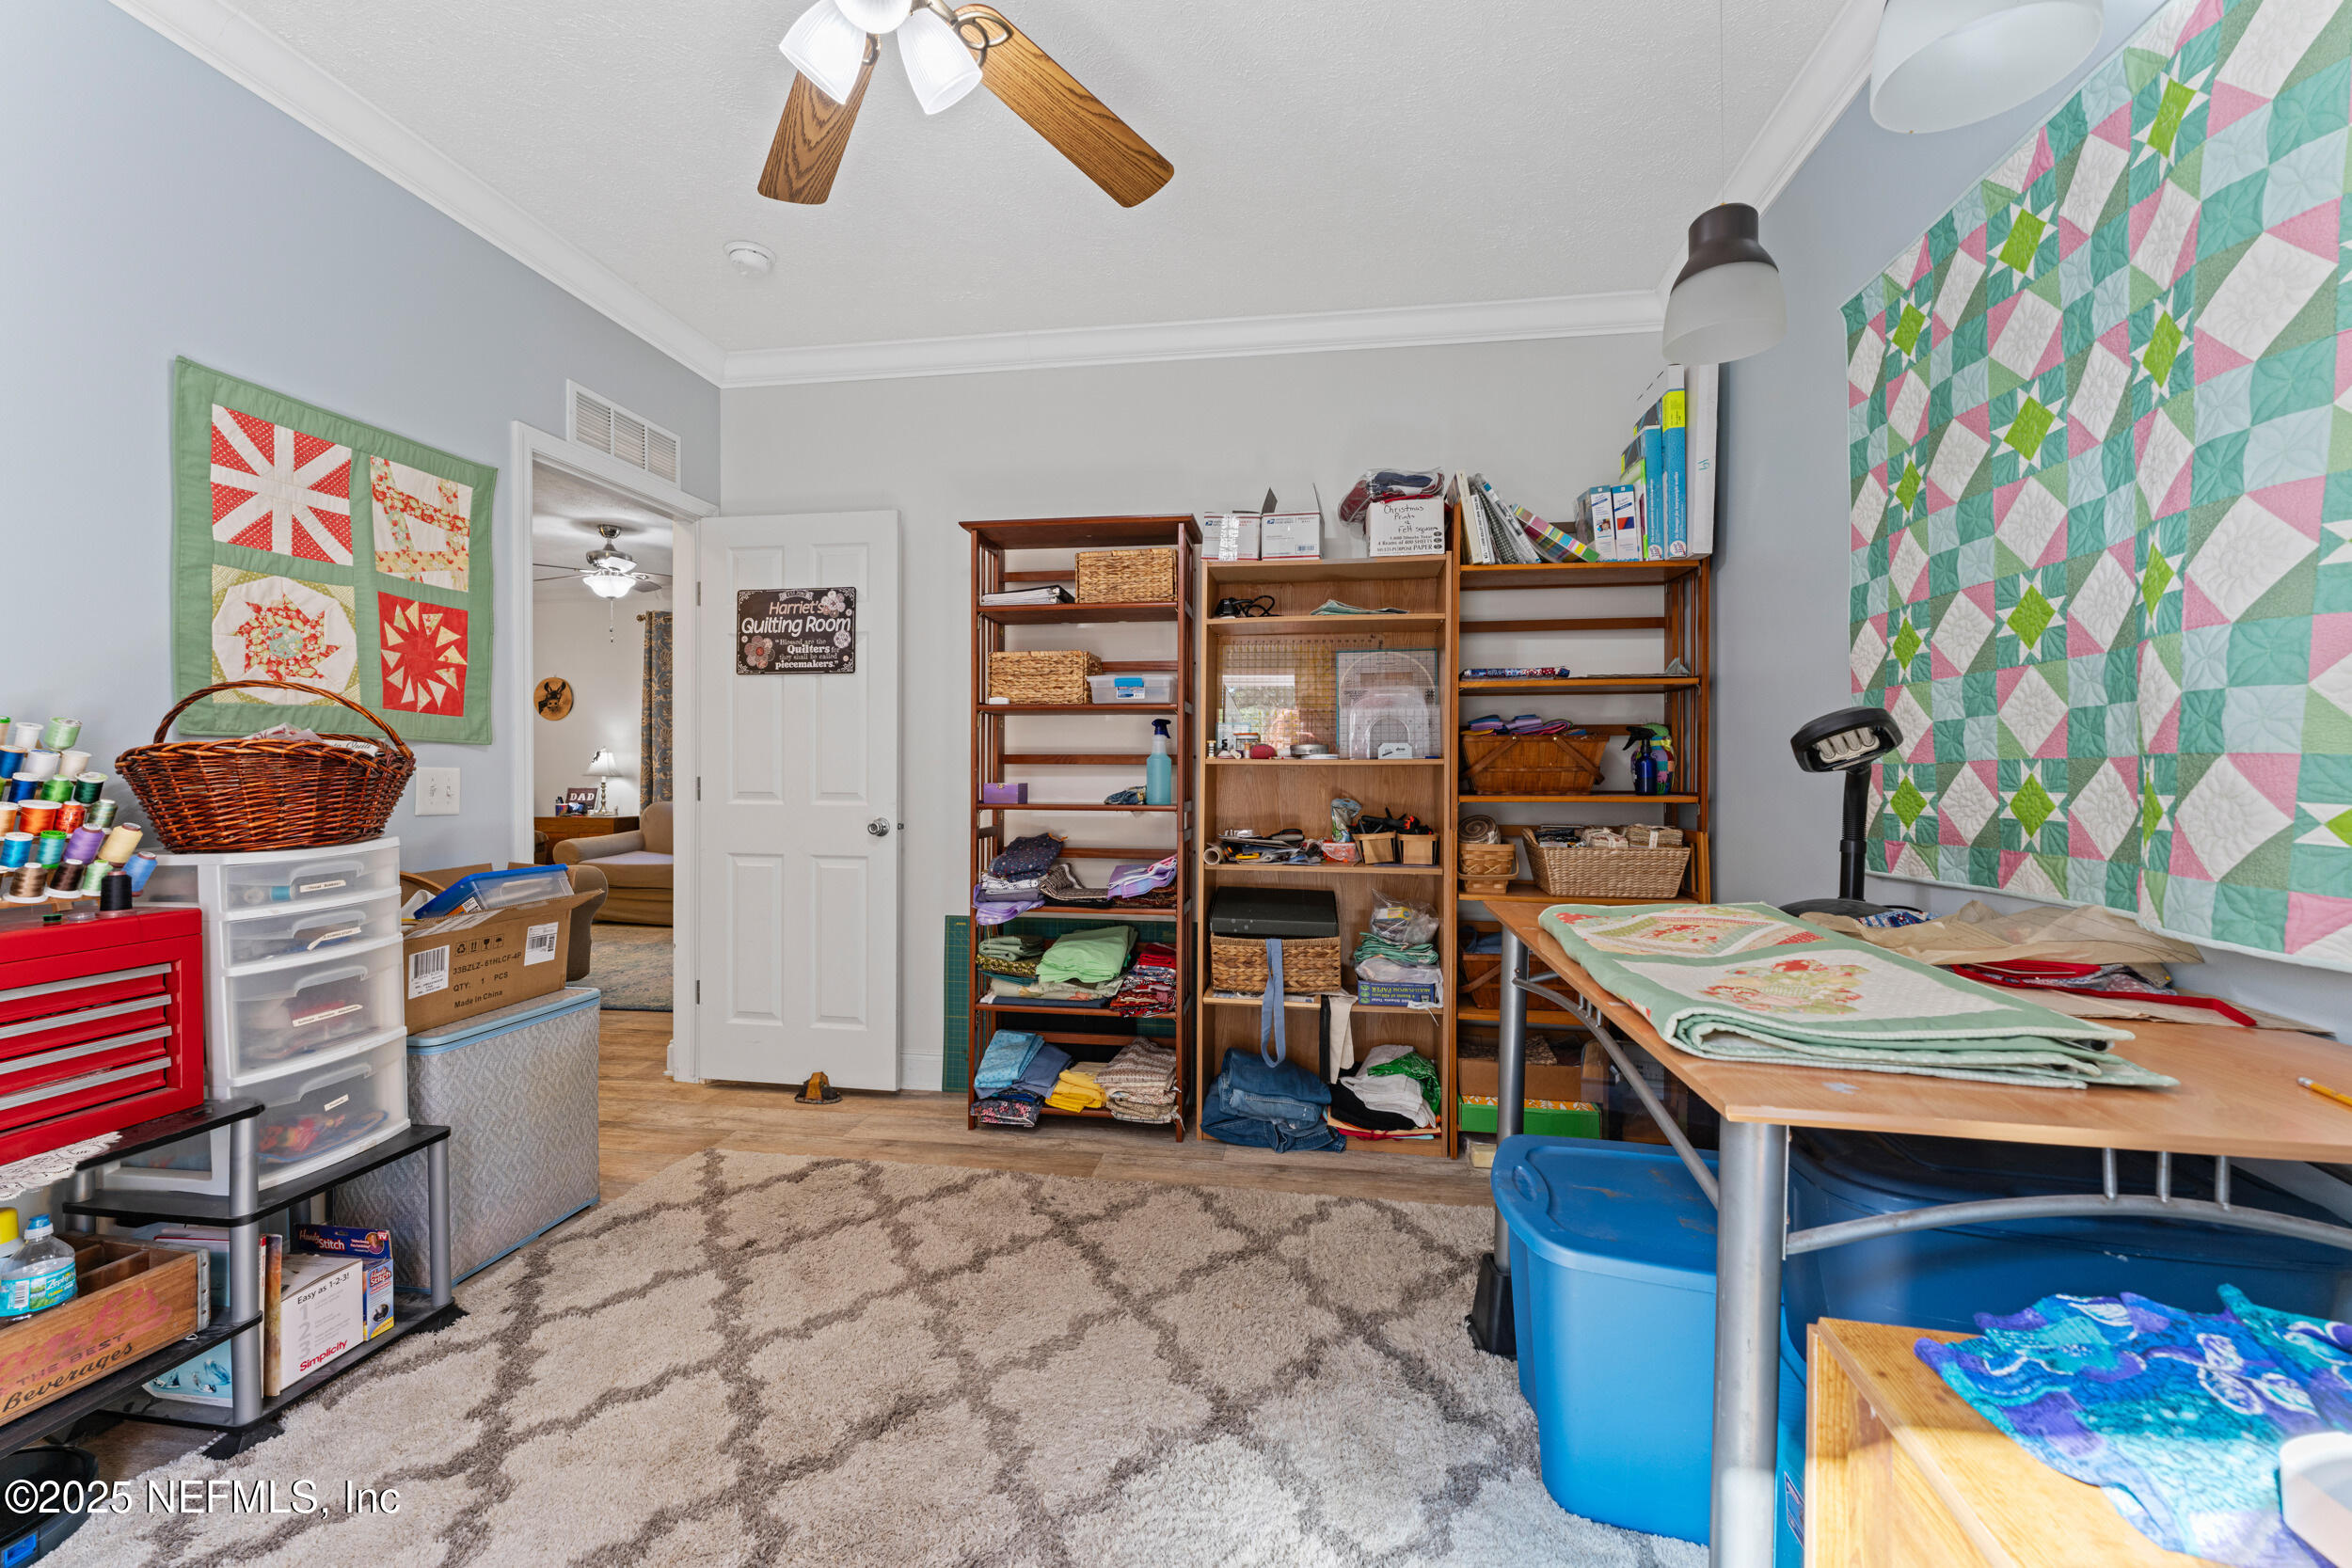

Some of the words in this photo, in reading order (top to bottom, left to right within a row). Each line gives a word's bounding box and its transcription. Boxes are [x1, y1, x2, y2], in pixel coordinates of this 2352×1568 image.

[1383, 504, 1424, 514] Christmas
[770, 600, 823, 615] Harriet's
[741, 616, 803, 637] Quilting
[805, 615, 850, 632] Room
[787, 644, 830, 655] Quilters
[494, 972, 508, 981] PCS
[454, 998, 473, 1008] Made
[484, 990, 502, 1001] China
[319, 1238, 345, 1250] Stitch
[370, 1270, 391, 1287] Stitch
[297, 1289, 316, 1305] Easy
[318, 1285, 327, 1294] as
[329, 1273, 350, 1288] 1-2-3!
[300, 1304, 308, 1320] 1
[299, 1322, 310, 1341] 2
[17, 1362, 60, 1386] THE
[70, 1332, 126, 1364] BEST
[299, 1340, 310, 1360] 3
[299, 1339, 347, 1371] Simplicity
[2, 1341, 134, 1413] Beverages
